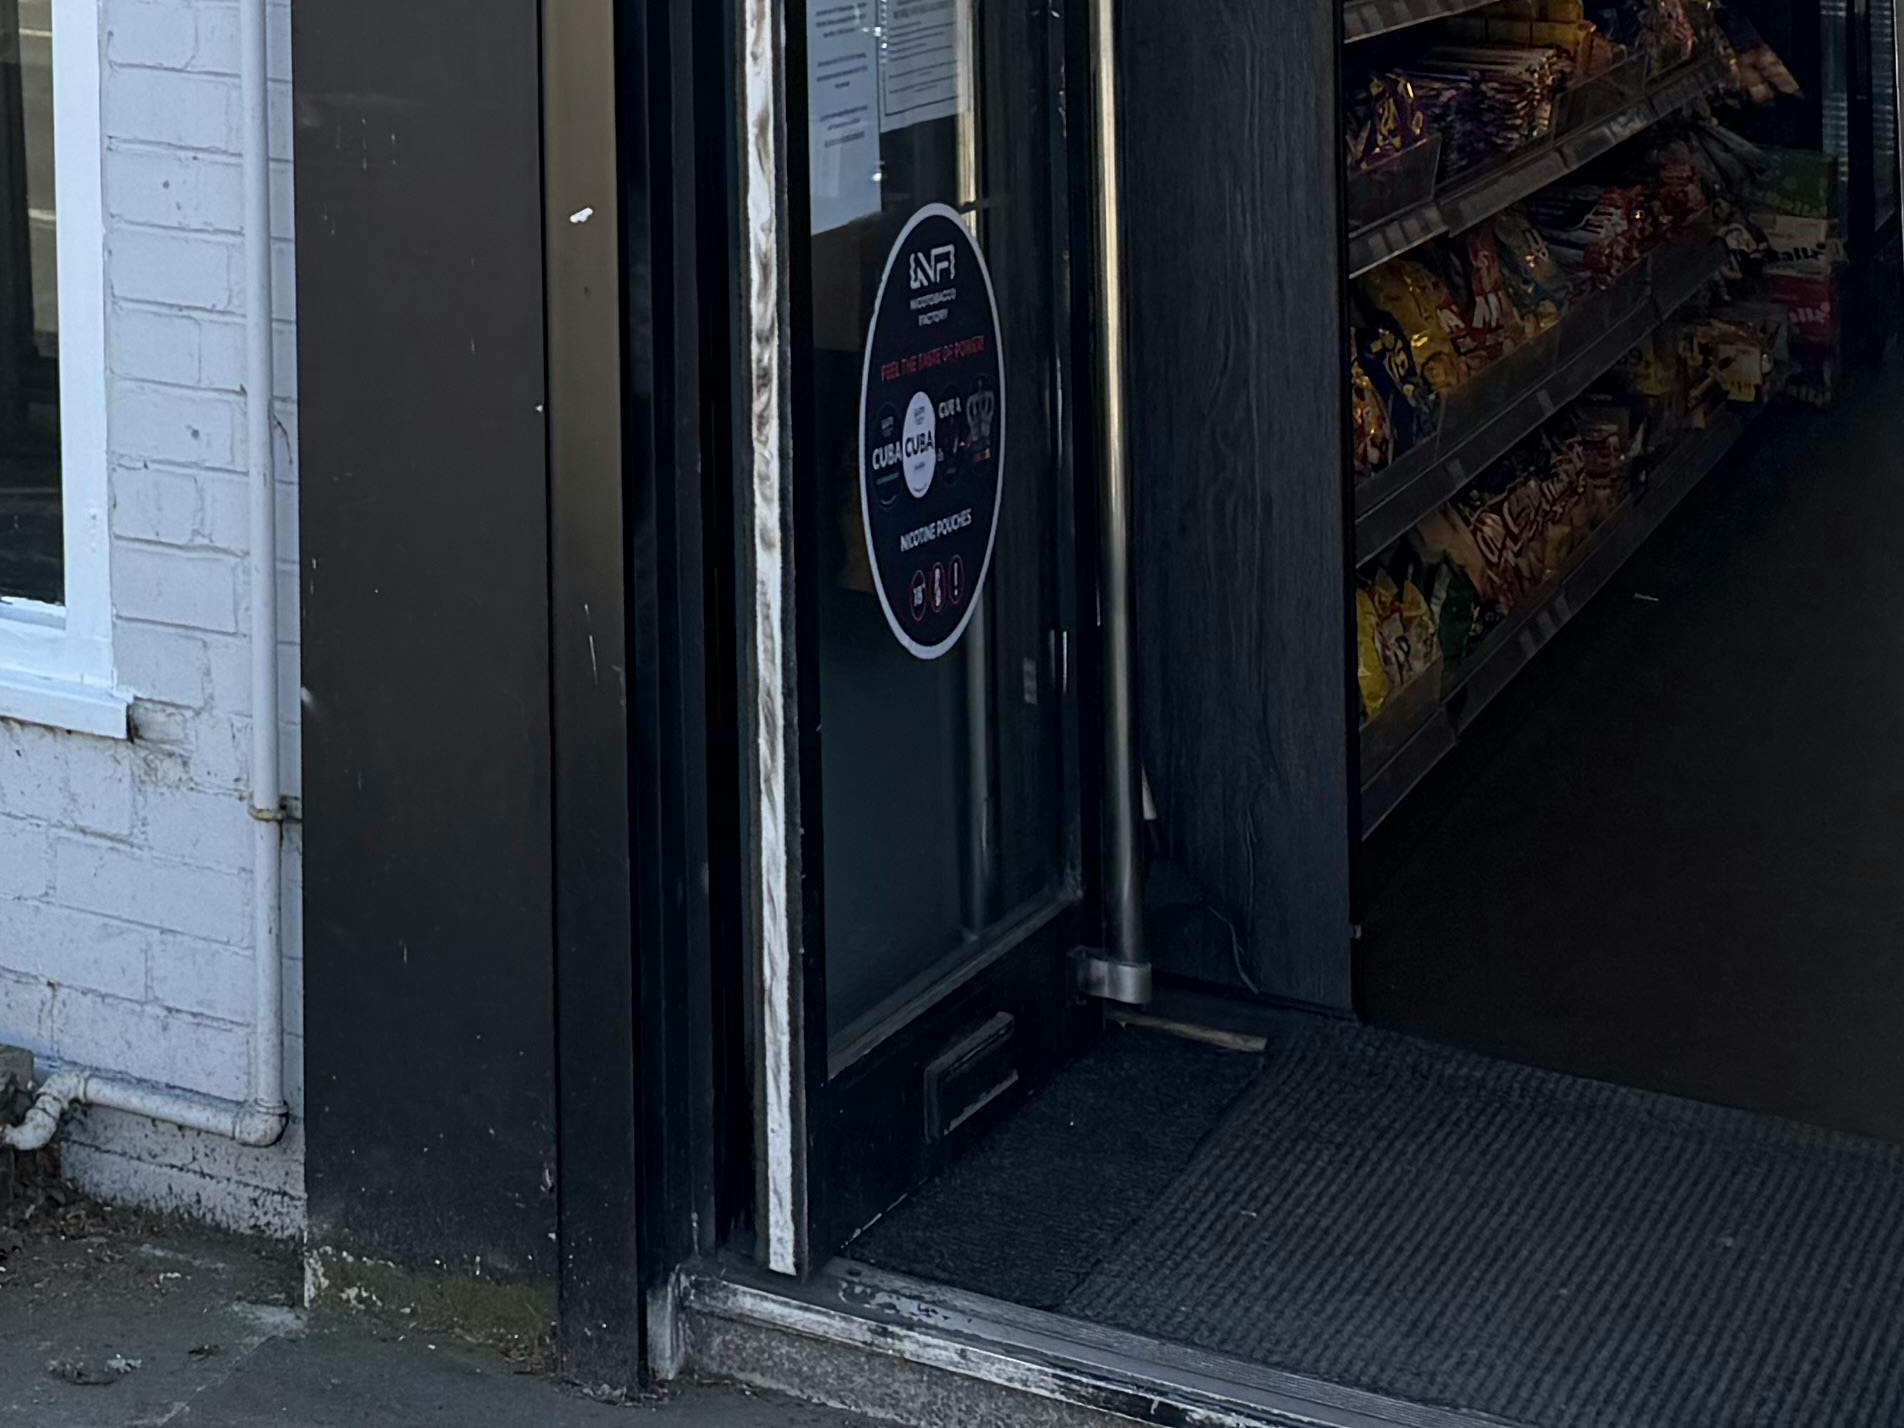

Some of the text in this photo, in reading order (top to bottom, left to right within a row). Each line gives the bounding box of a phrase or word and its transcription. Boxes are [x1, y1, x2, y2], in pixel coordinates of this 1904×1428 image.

[872, 441, 903, 471] CUBA
[905, 429, 935, 458] CUBA
[900, 507, 973, 553] NICOTINE POUCHES
